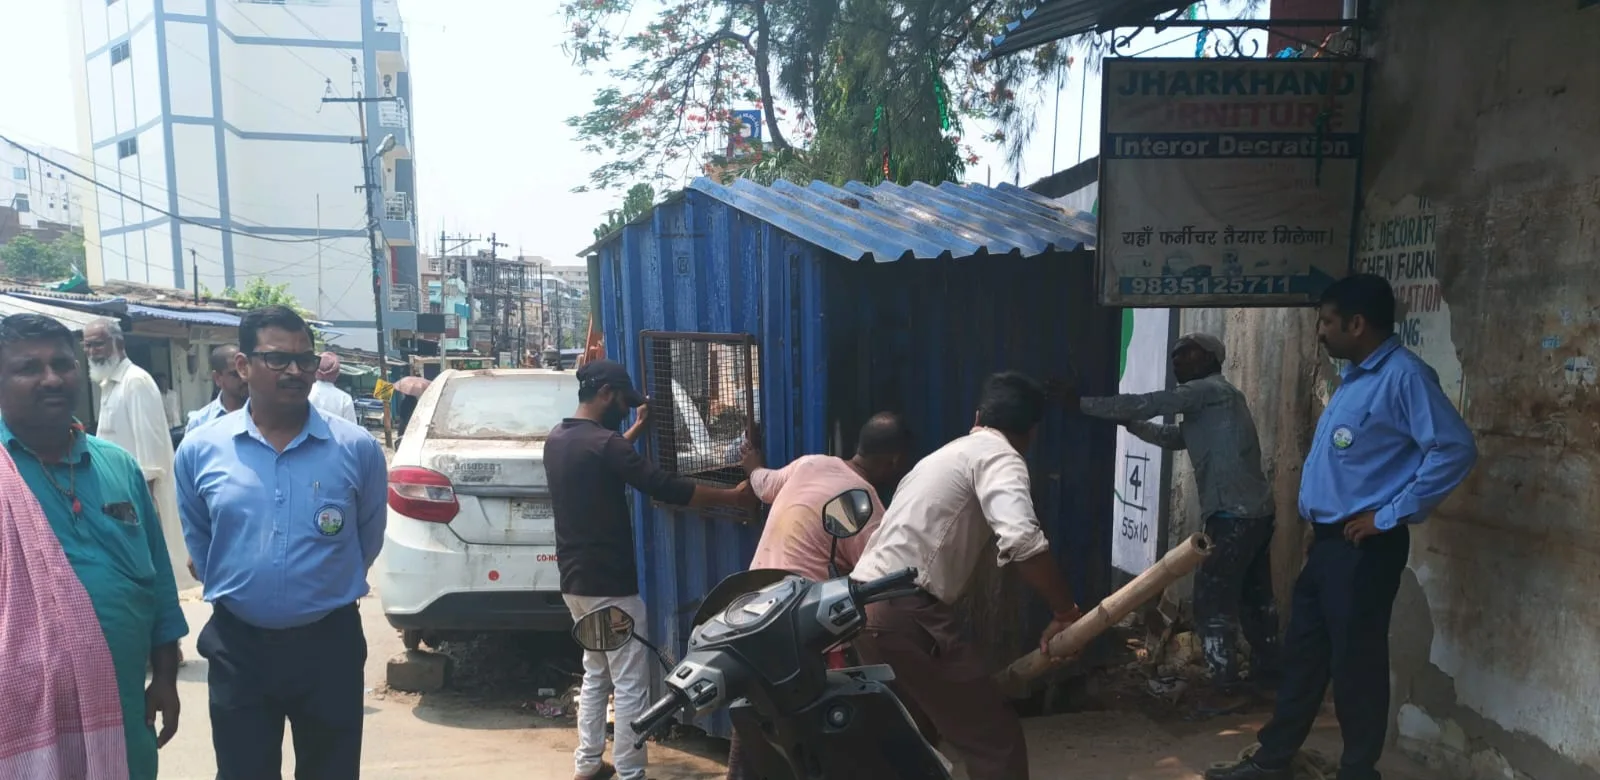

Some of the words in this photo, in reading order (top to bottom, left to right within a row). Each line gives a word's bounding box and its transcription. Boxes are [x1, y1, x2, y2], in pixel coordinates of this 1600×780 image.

[1117, 69, 1355, 97] JHARKHAND
[1114, 136, 1210, 156] Interor
[1218, 135, 1350, 156] Decration
[1159, 225, 1218, 246] फर्नीचर
[1223, 225, 1267, 245] तैयार
[1130, 277, 1290, 295] 9835125711
[1129, 464, 1142, 501] 4
